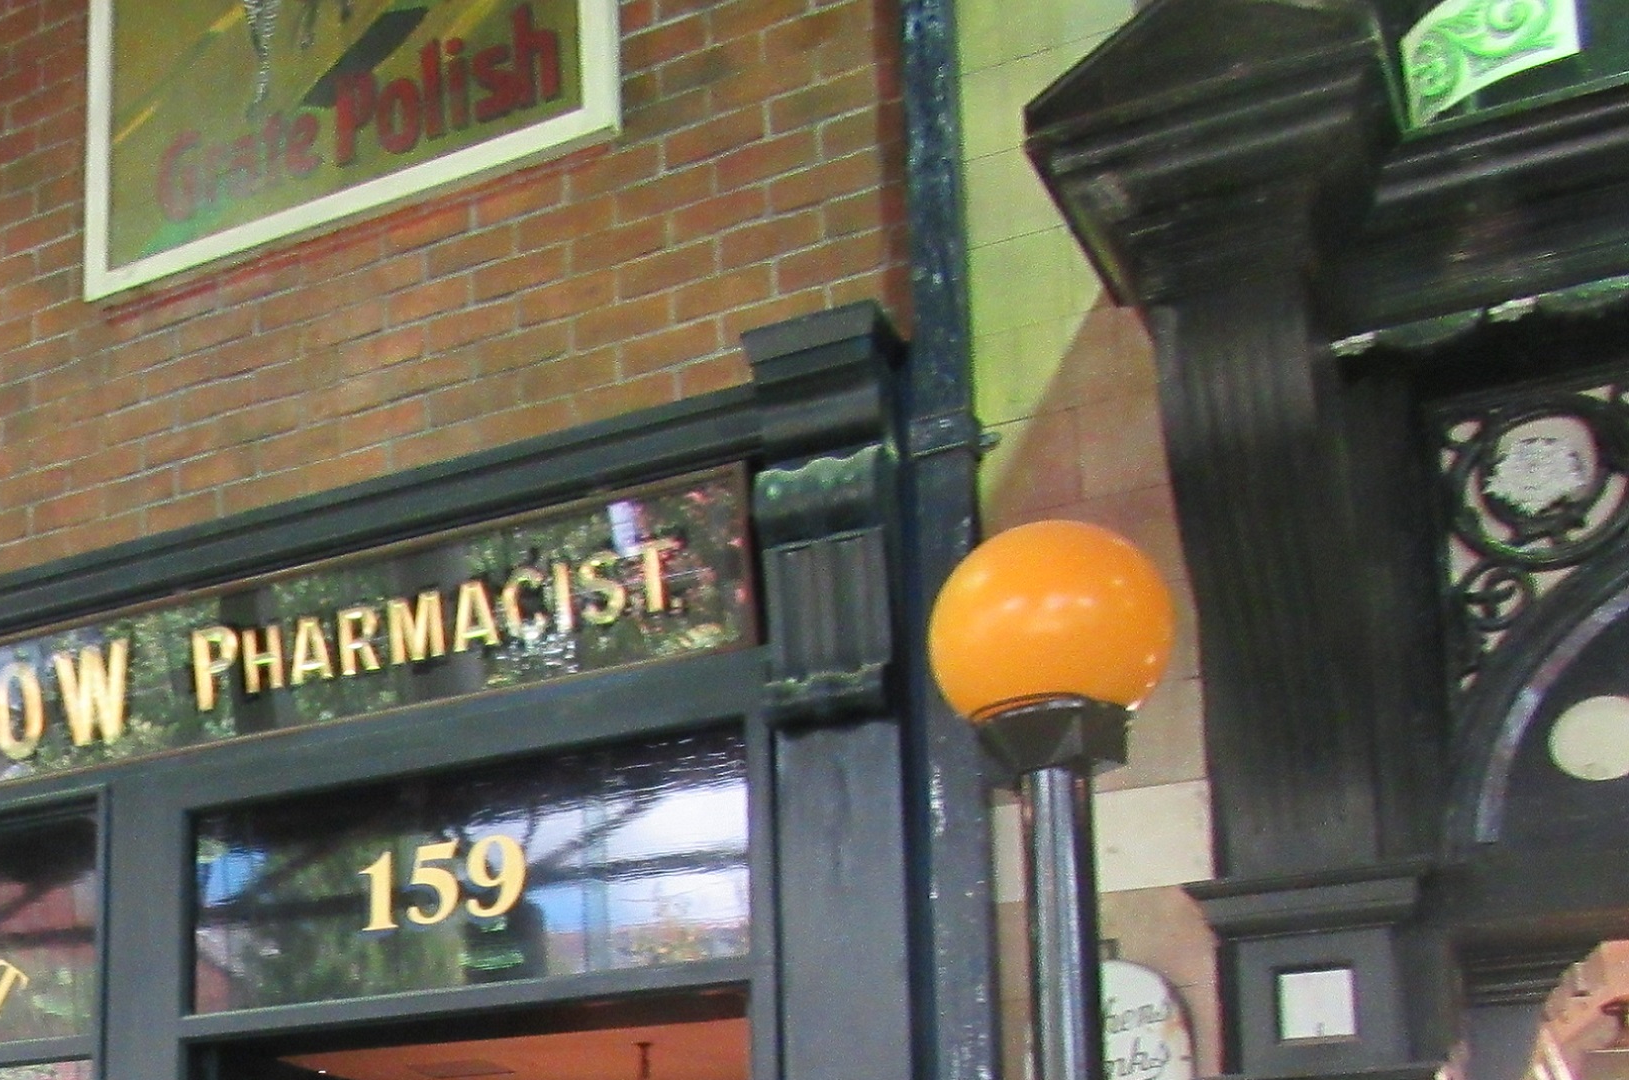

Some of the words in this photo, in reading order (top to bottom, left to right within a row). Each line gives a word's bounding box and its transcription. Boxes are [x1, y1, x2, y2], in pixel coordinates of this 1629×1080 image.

[157, 110, 324, 225] Grate
[333, 3, 561, 168] Polish
[359, 834, 528, 932] 159
